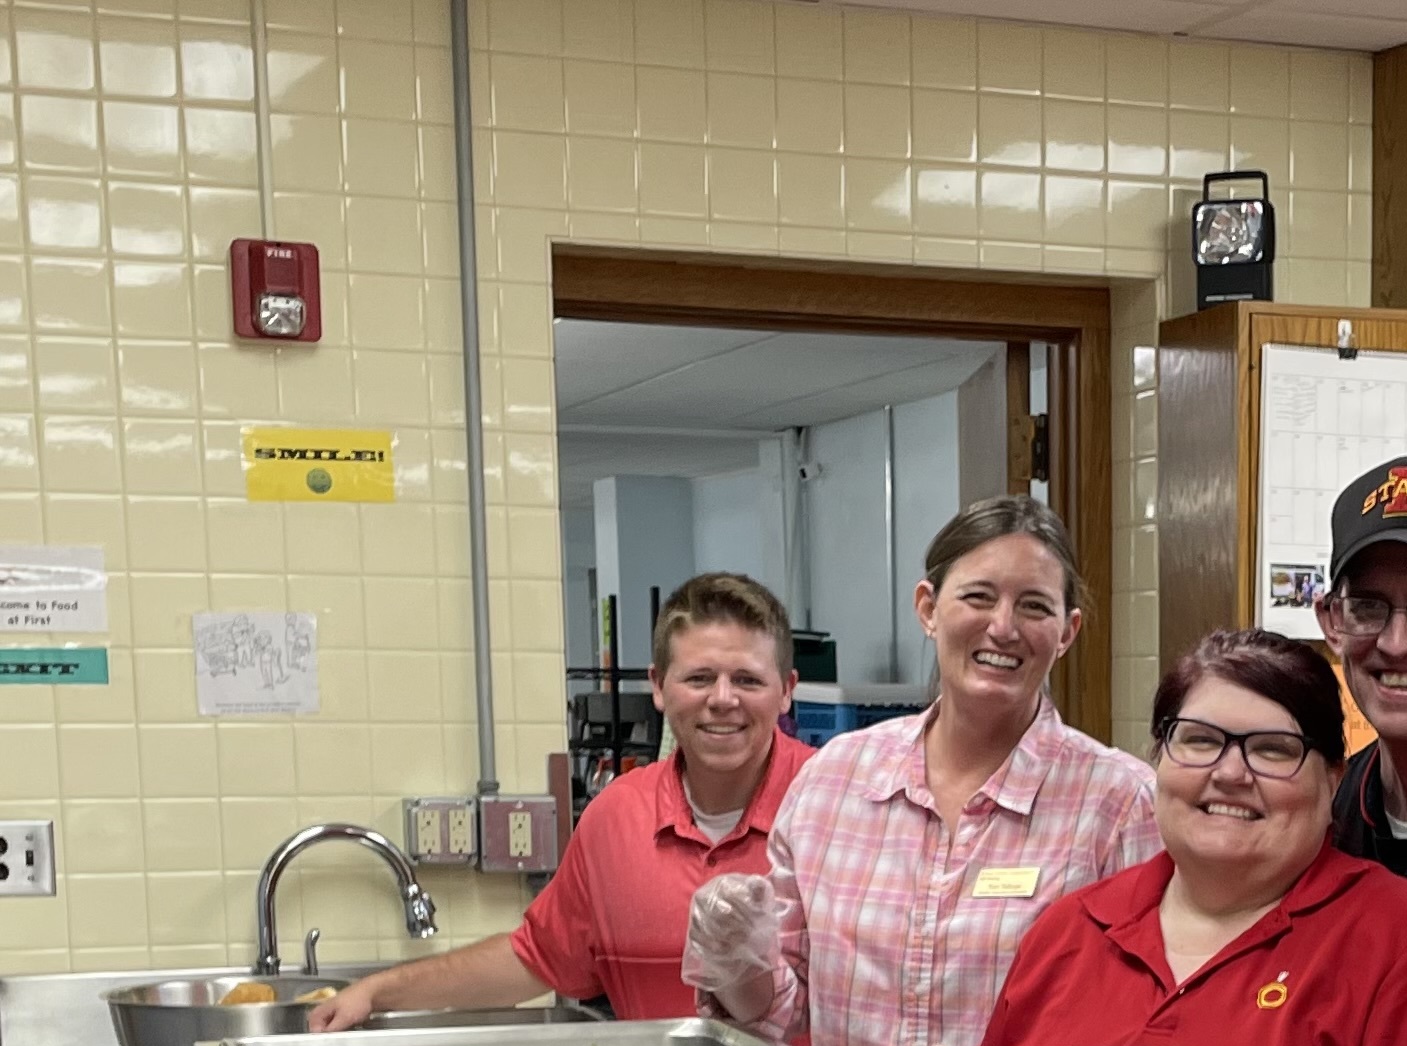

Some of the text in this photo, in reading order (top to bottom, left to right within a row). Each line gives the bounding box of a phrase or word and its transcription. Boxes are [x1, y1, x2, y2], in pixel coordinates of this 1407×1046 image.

[267, 249, 292, 258] FIRE
[255, 448, 384, 462] SMILE!
[0, 600, 79, 611] come to Food
[7, 615, 52, 625] at First
